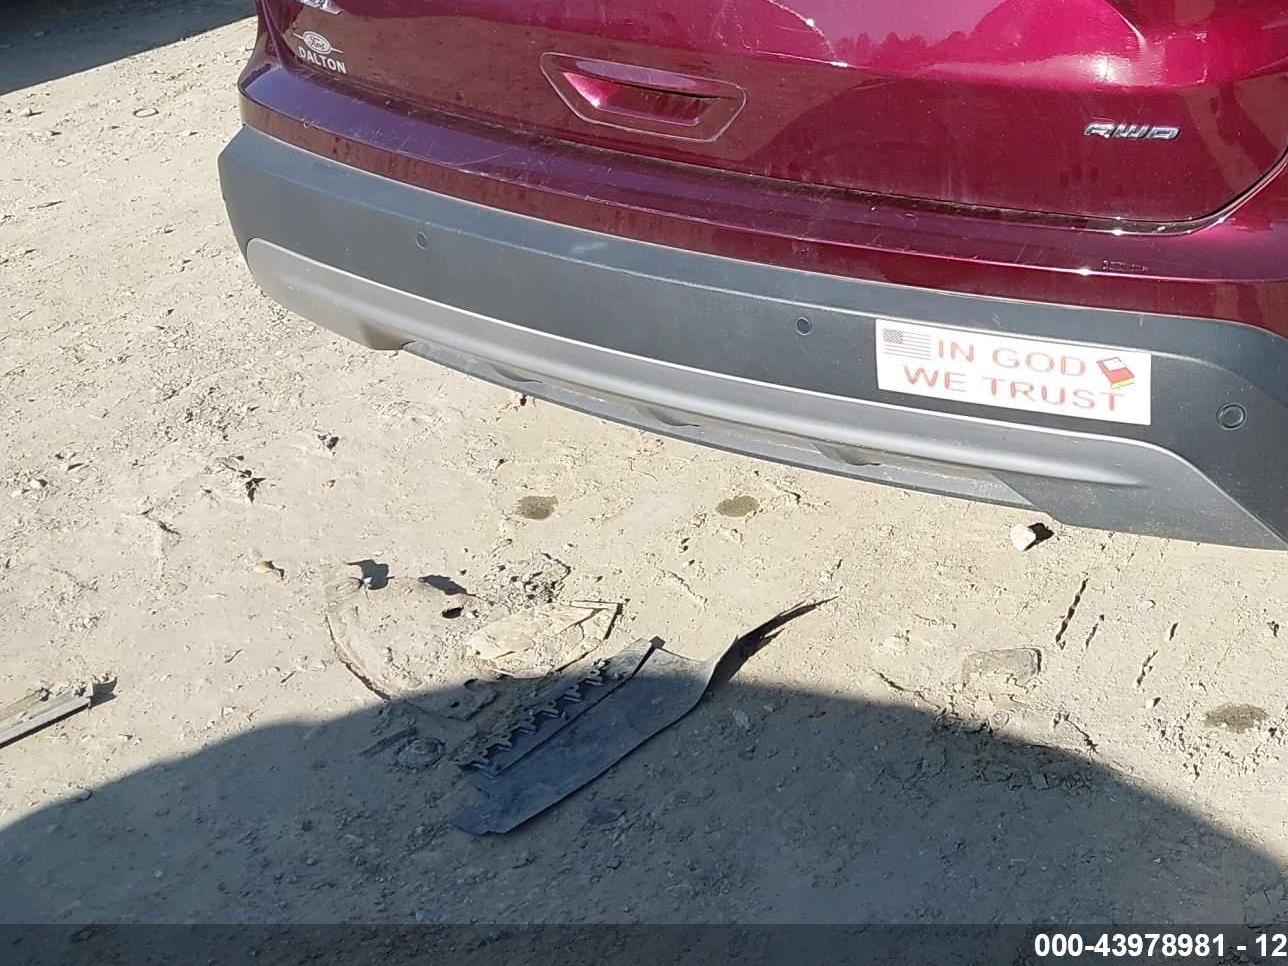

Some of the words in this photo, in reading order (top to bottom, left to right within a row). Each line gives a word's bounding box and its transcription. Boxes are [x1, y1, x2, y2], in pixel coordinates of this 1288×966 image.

[298, 45, 347, 74] DALTON
[1083, 123, 1180, 139] AWD
[938, 339, 975, 363] IN
[992, 346, 1086, 377] GOD
[903, 364, 968, 393] WE
[981, 375, 1125, 412] TRUST
